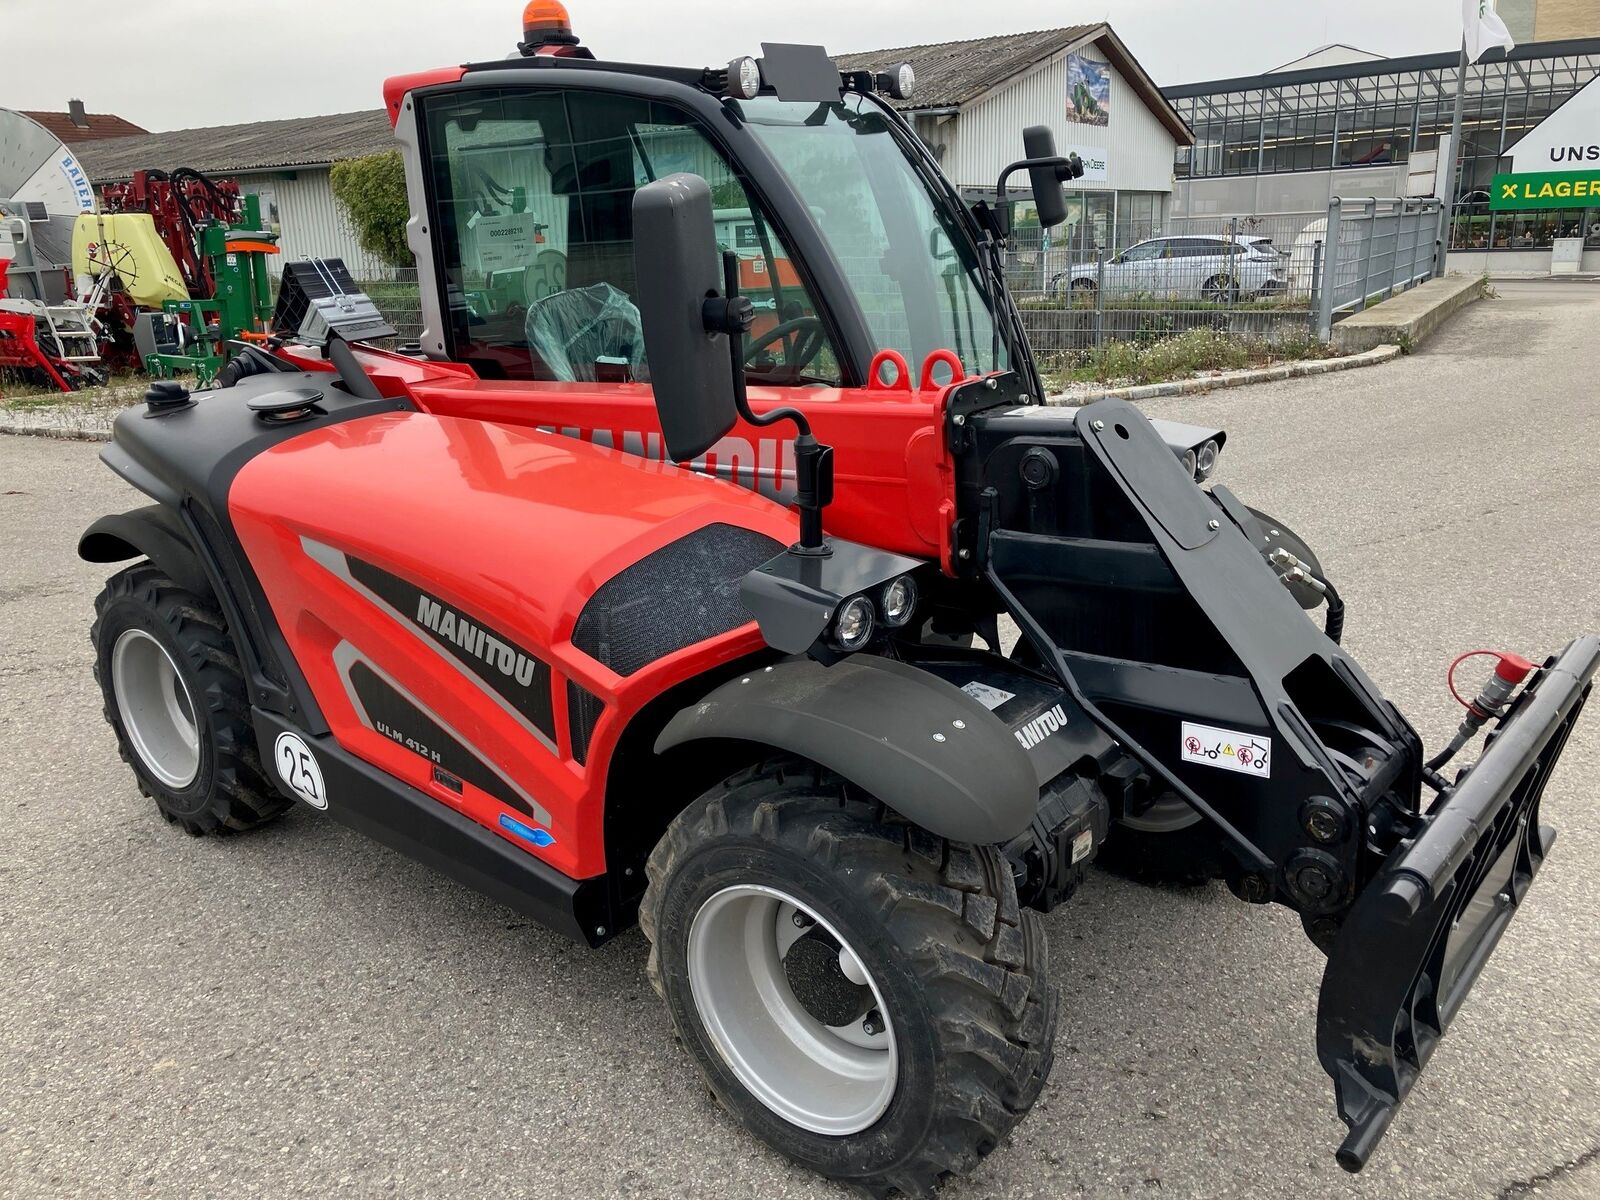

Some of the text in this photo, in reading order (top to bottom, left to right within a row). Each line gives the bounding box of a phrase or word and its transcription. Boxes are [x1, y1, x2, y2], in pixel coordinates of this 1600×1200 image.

[62, 156, 92, 208] BAUER
[416, 594, 537, 688] MANITOU
[377, 721, 441, 764] ULM 412 H
[1014, 703, 1068, 750] ANITOU
[282, 745, 319, 801] 25
